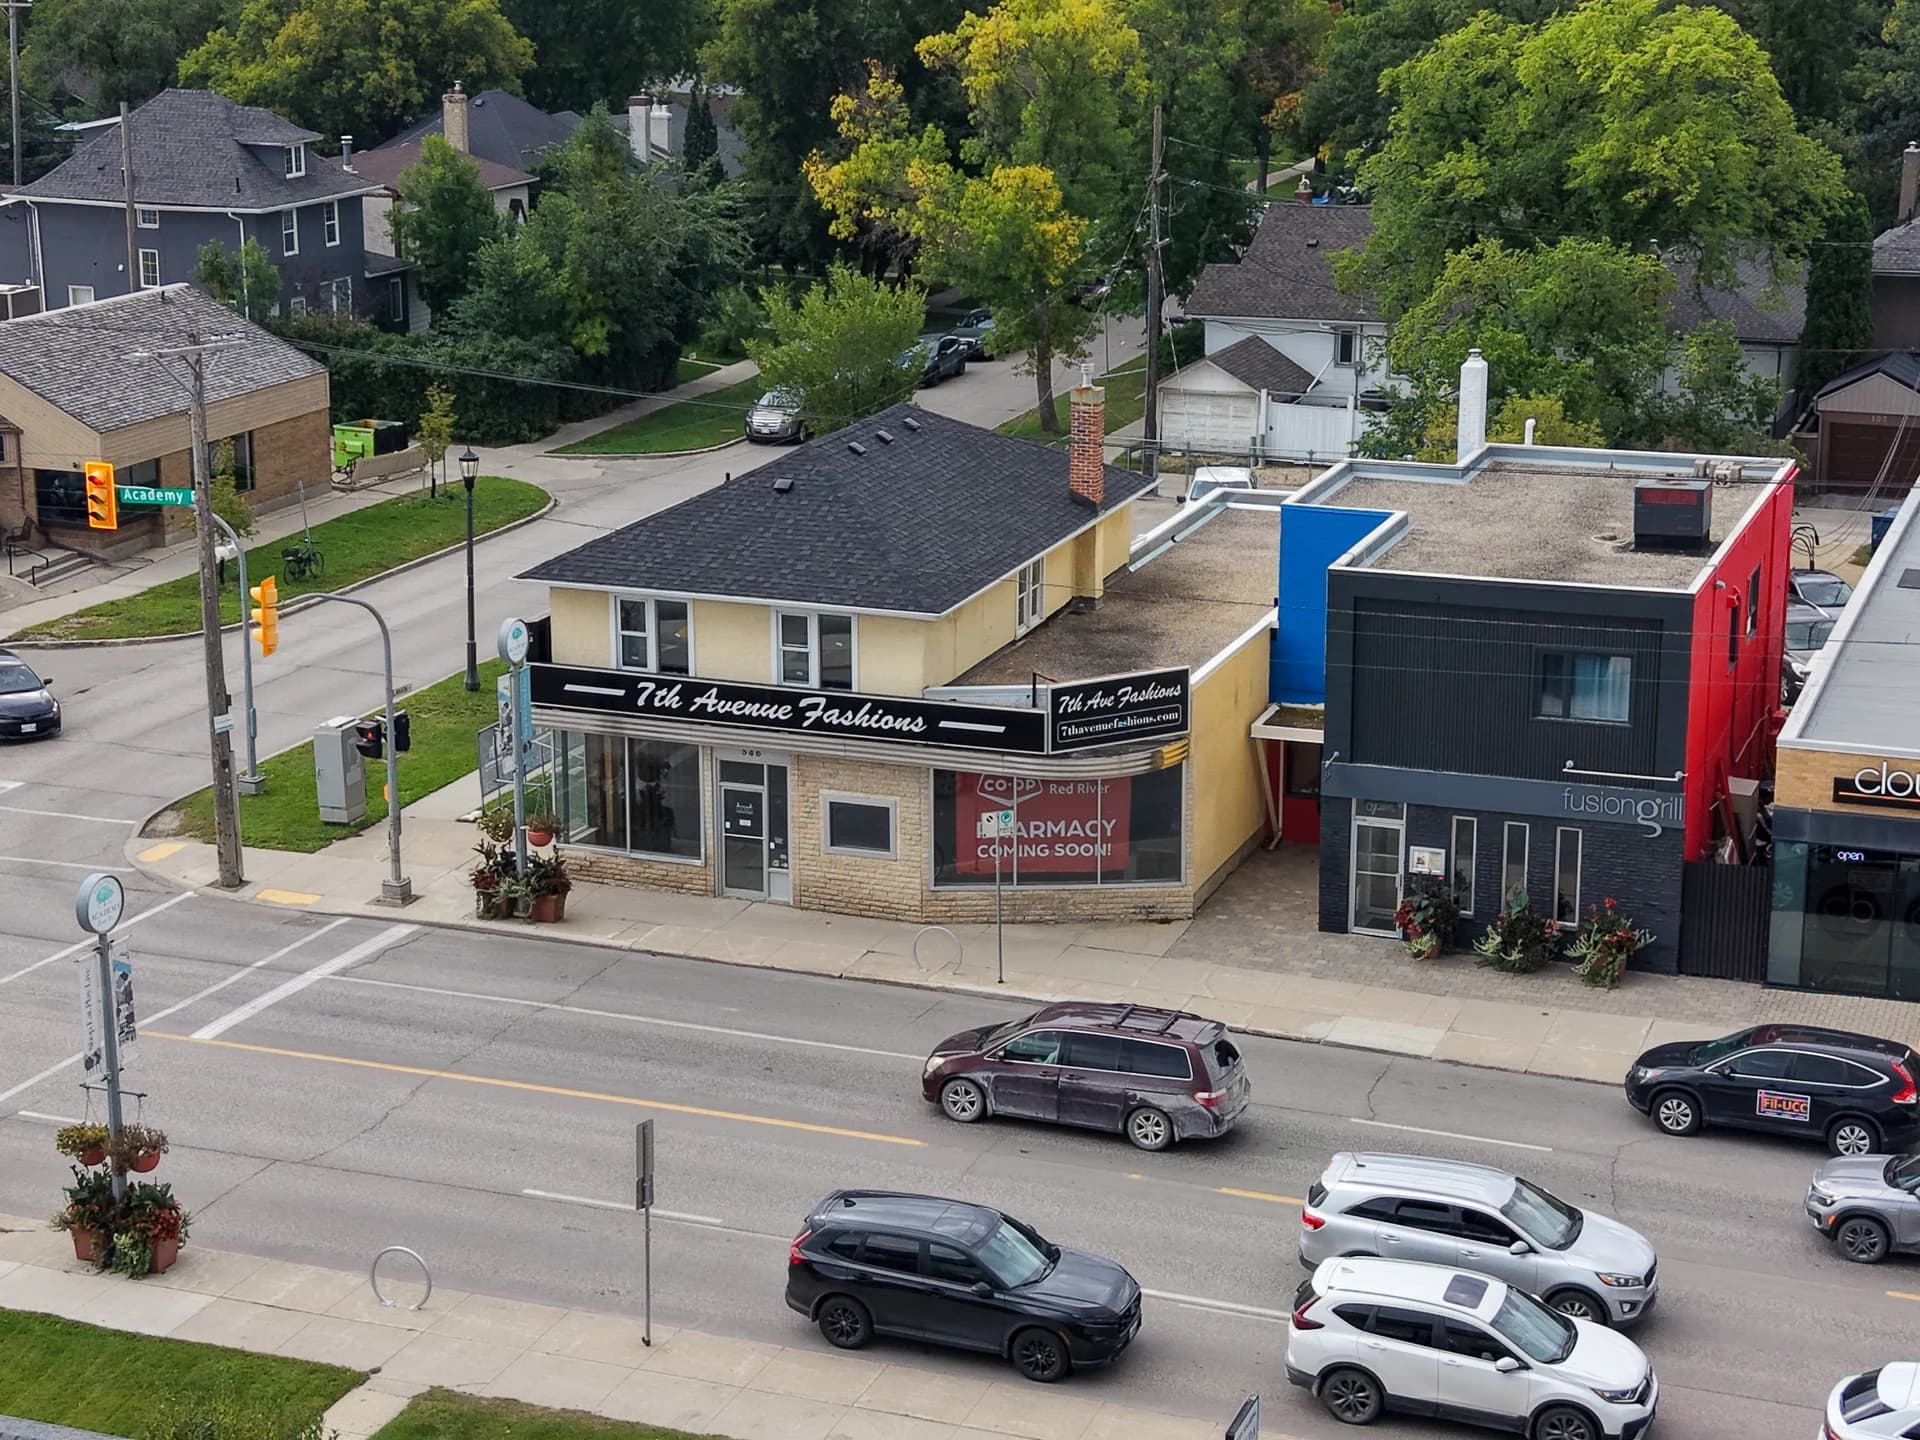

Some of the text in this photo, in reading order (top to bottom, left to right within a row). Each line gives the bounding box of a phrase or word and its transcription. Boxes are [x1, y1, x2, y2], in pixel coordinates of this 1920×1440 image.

[124, 488, 183, 505] Academy
[637, 681, 927, 732] 7th Avenue Fashions
[1058, 681, 1182, 714] 7th Ave Fashions
[1049, 783, 1073, 795] Red
[1562, 787, 1683, 838] fusiongrill
[976, 819, 1117, 839] ARMACY
[977, 842, 1112, 858] COMING SOON!
